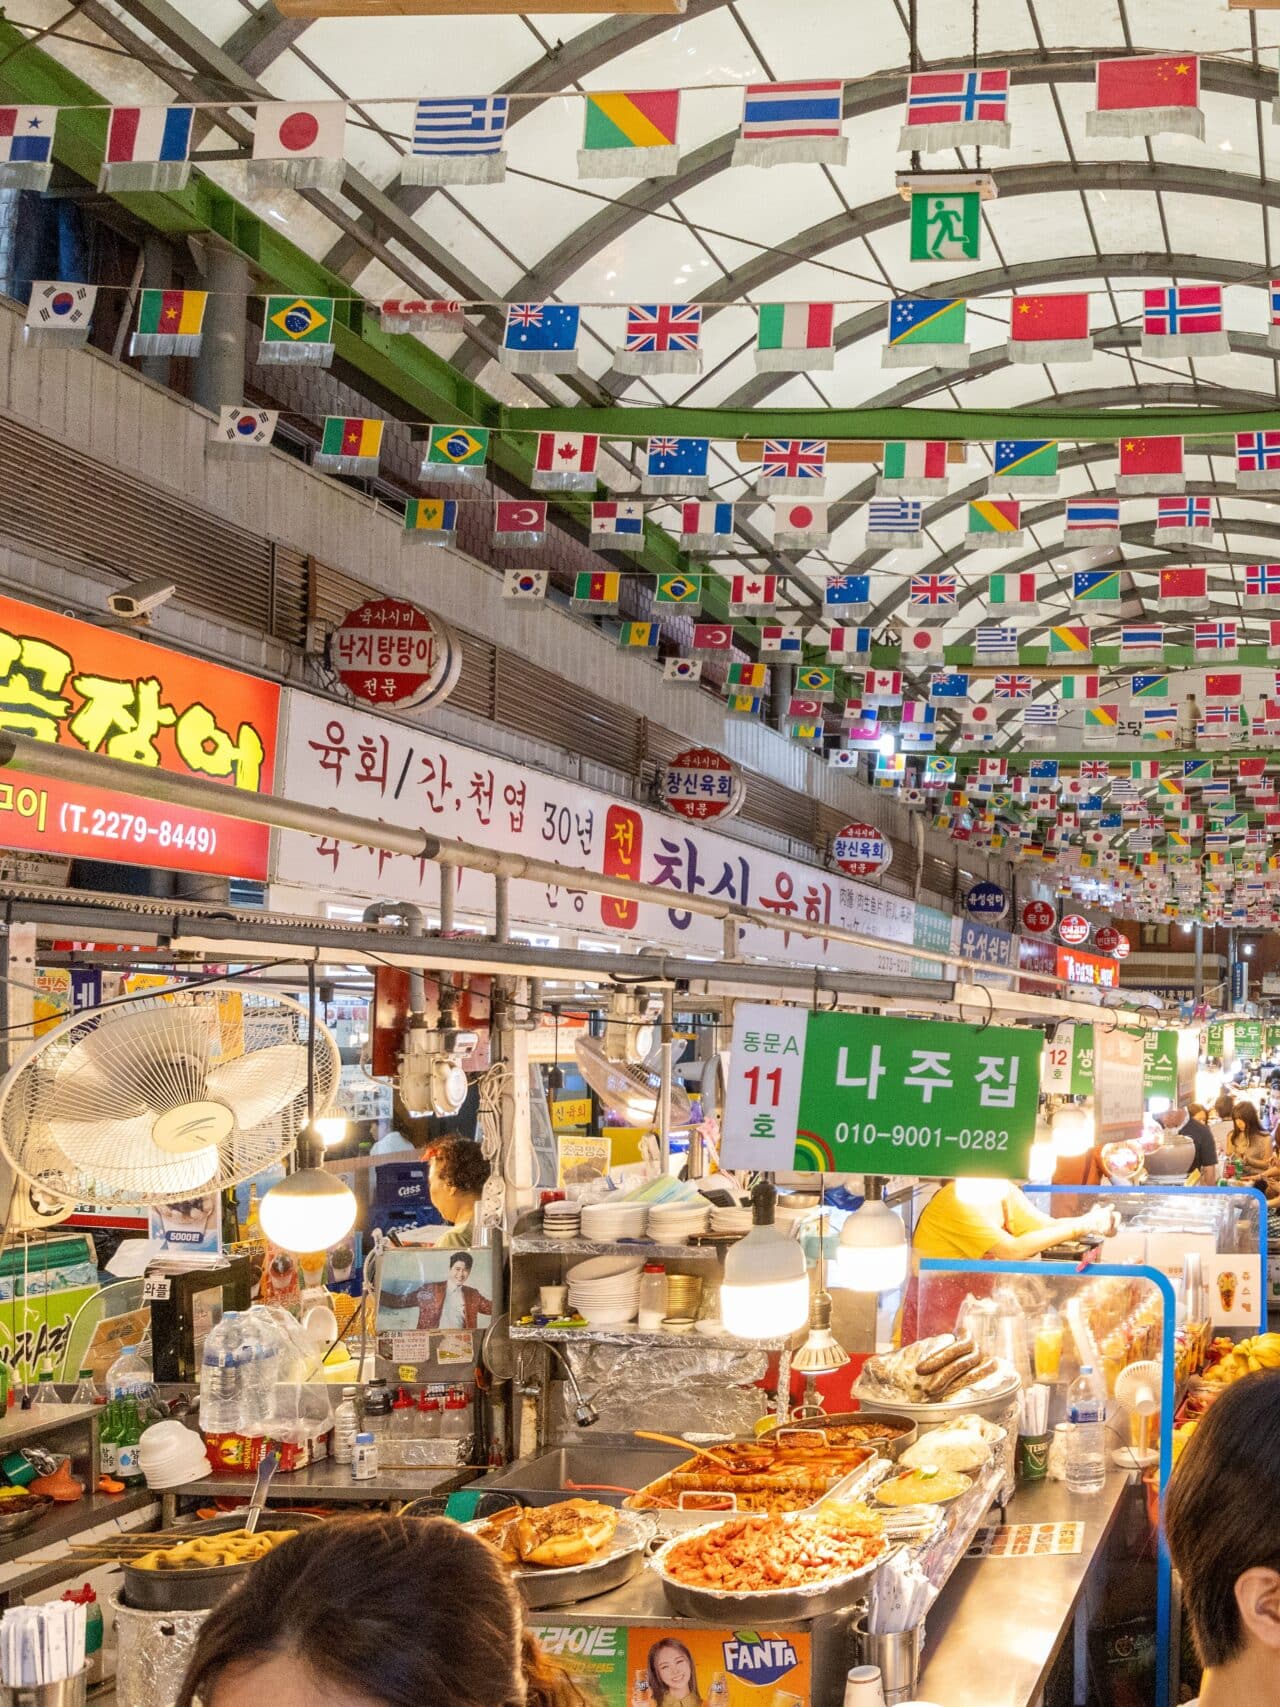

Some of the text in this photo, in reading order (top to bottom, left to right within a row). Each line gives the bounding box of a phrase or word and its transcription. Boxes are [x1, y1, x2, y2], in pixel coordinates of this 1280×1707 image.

[359, 609, 415, 627] 육사시미
[339, 634, 433, 667] 낙지탕탕이
[363, 677, 397, 698] 전문
[667, 772, 732, 798] 창신육회
[685, 802, 708, 816] 전문
[59, 802, 217, 855] (T.2279-8449)
[541, 802, 594, 856] 30년
[835, 840, 884, 860] 창신육회
[742, 1031, 799, 1056] 동문A
[1050, 1050, 1067, 1065] 12
[744, 1065, 782, 1107] 11
[836, 1045, 1020, 1108] 나주집
[750, 1113, 776, 1138] 호
[835, 1122, 1009, 1151] 010-9001-0282
[145, 1283, 168, 1298] 와플
[725, 1640, 797, 1671] FANTA
